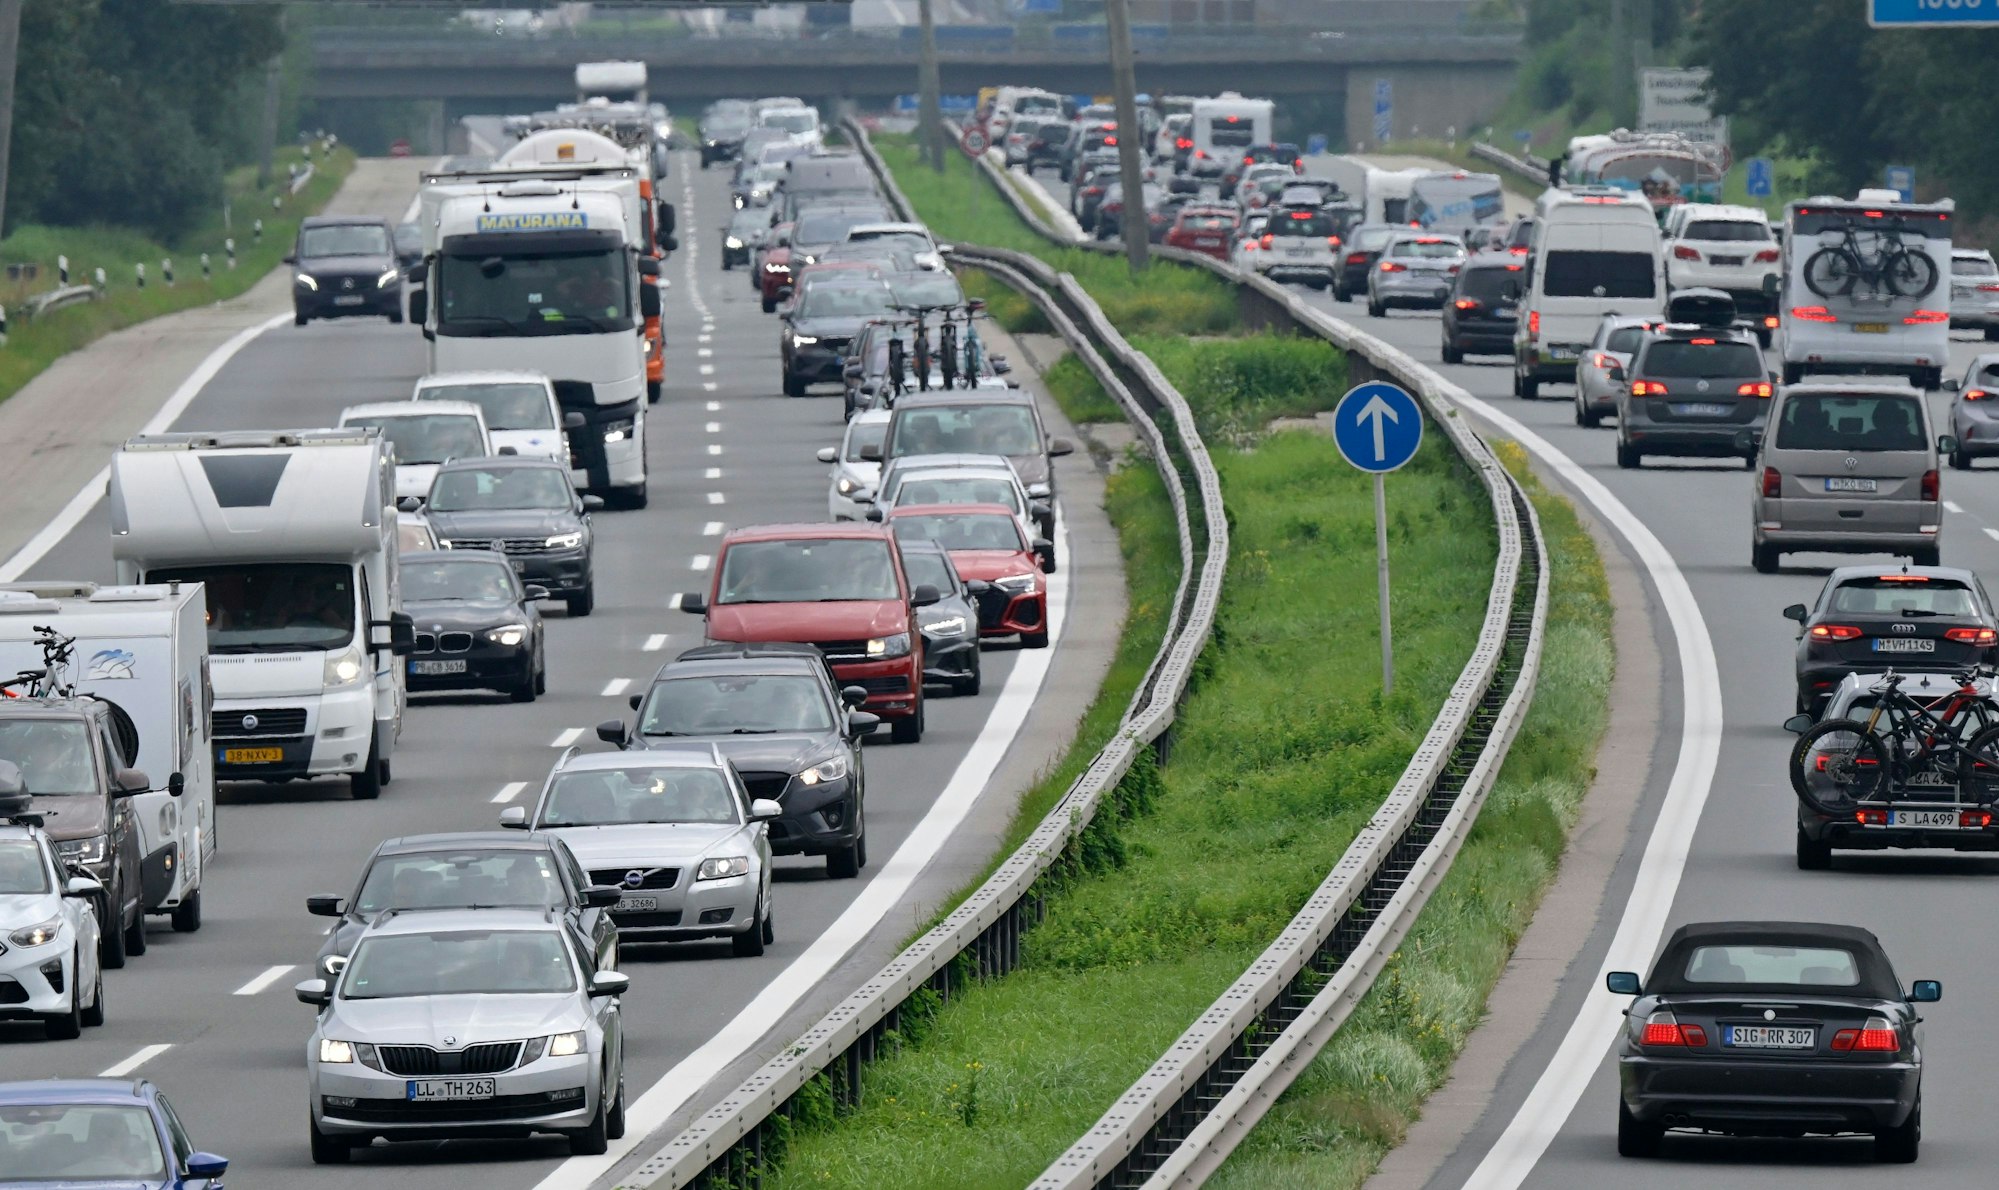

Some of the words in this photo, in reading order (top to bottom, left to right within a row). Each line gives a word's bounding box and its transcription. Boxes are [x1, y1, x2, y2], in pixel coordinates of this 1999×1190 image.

[481, 213, 584, 229] MATURANA
[1879, 639, 1885, 650] M
[1899, 813, 1907, 824] S
[1734, 1028, 1758, 1043] SIG
[1768, 1029, 1784, 1043] RR
[1788, 1030, 1812, 1044] 307
[416, 1083, 434, 1096] LL
[444, 1082, 463, 1095] TH
[466, 1081, 492, 1095] 263
